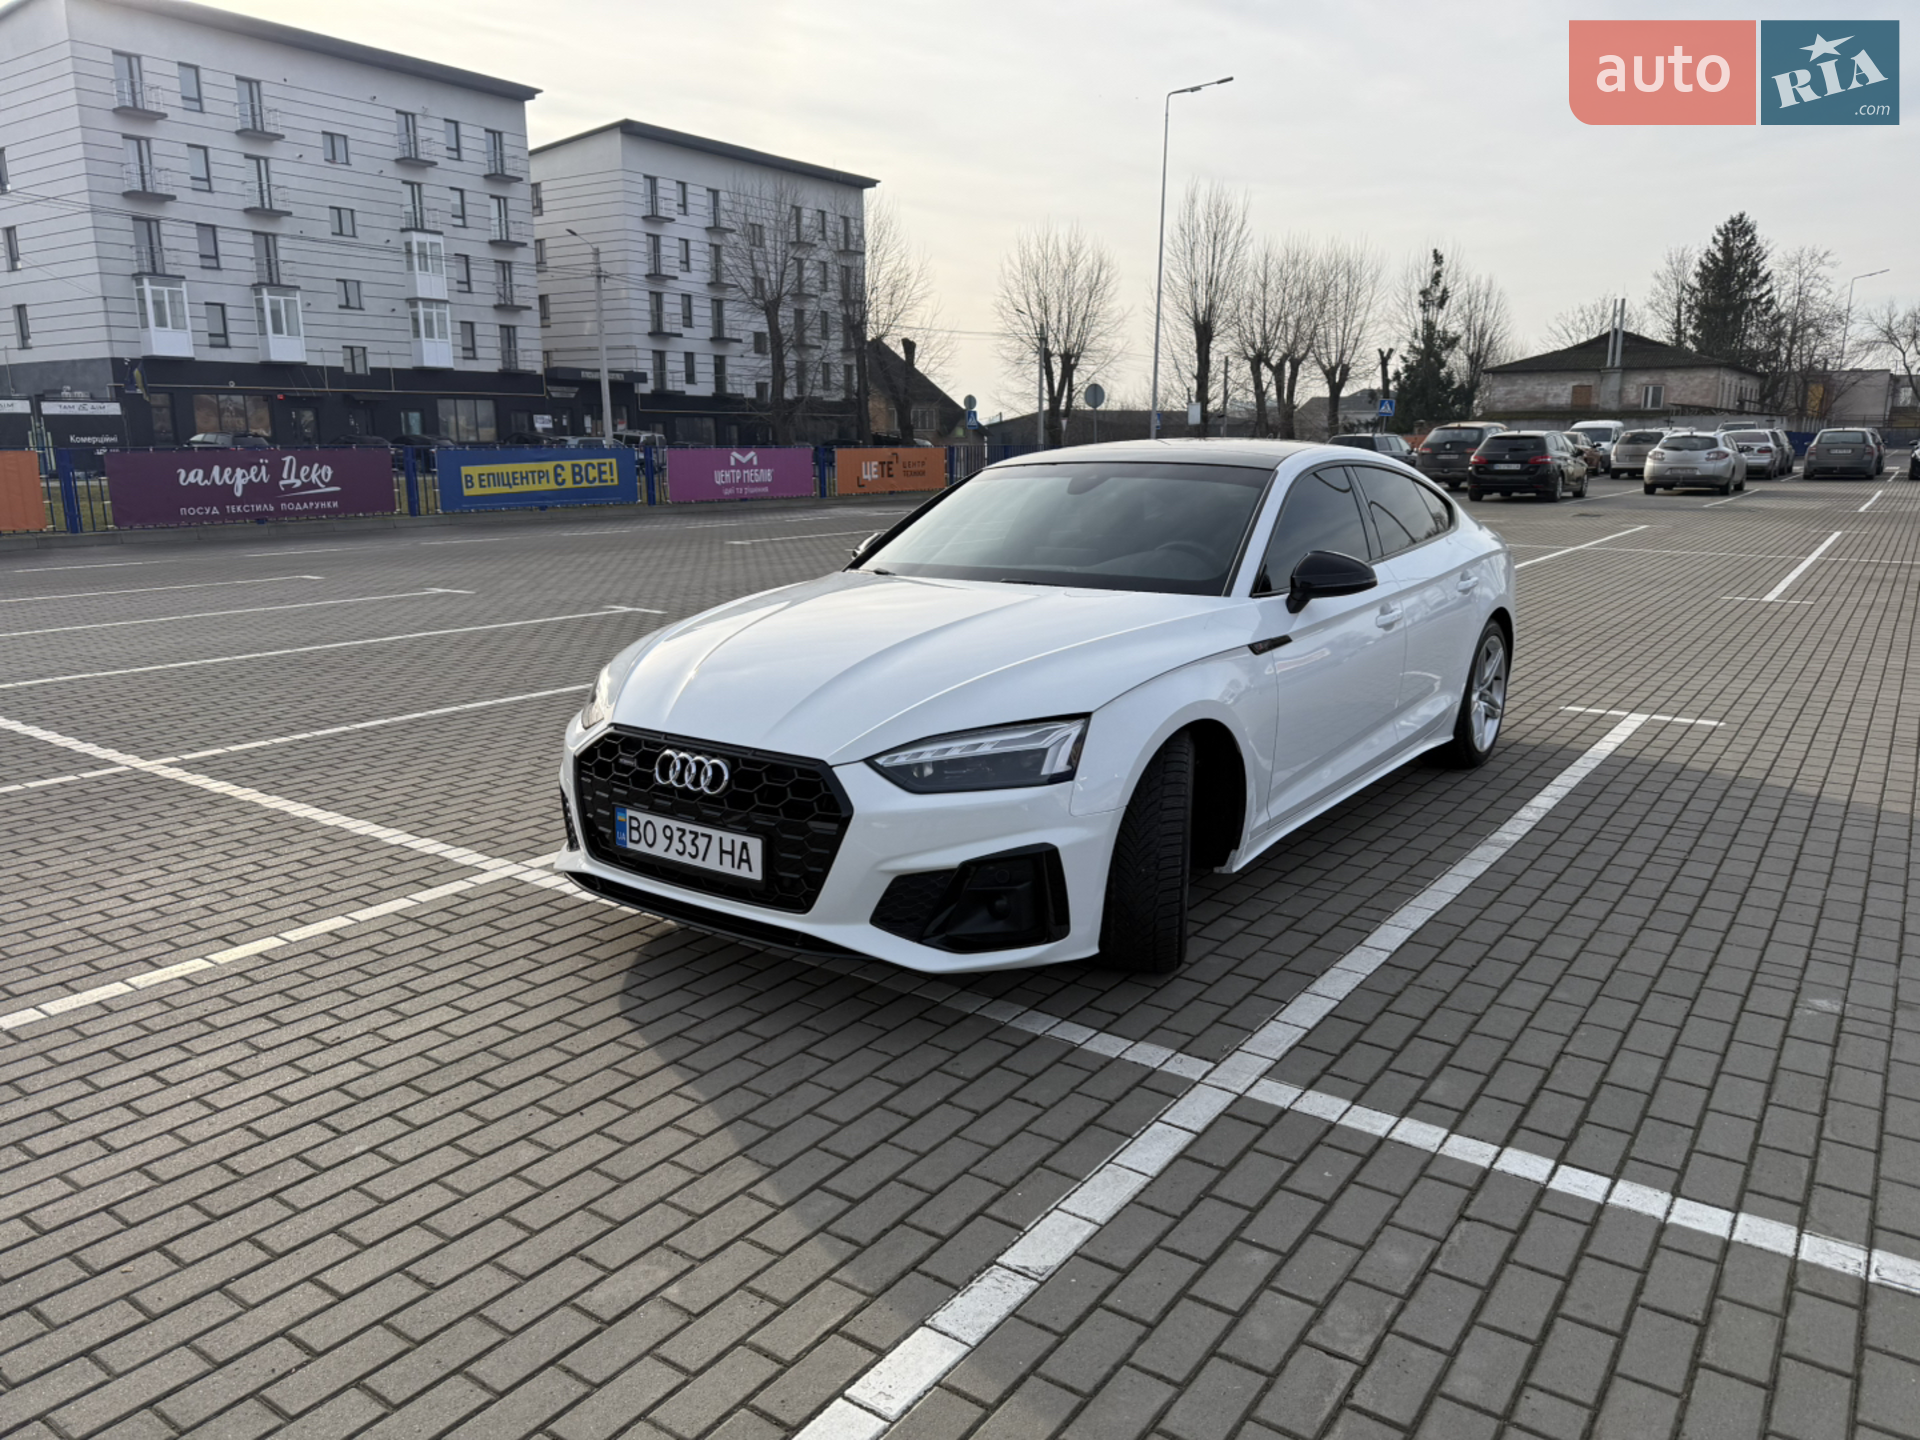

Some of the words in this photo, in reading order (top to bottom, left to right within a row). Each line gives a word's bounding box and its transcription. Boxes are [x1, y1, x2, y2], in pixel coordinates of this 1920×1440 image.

[69, 434, 118, 444] Комерційні
[862, 461, 894, 481] ЦЕТЕ
[902, 460, 926, 469] ЦЕНТР
[177, 458, 270, 497] галереї
[278, 455, 334, 491] Деко
[464, 474, 475, 489] В
[477, 469, 550, 489] ЕПІЦЕНТРІ
[553, 463, 566, 487] Є
[571, 461, 615, 486] ВСЕ!
[714, 469, 741, 485] ЦЕНТР
[180, 506, 220, 516] ПОСУД
[225, 503, 275, 514] ТЕКСТИЛЬ
[280, 500, 339, 511] ПОДАРУНКИ
[616, 831, 626, 841] UA
[628, 815, 657, 848] BO
[662, 825, 713, 862] 9337
[719, 836, 753, 873] HA
